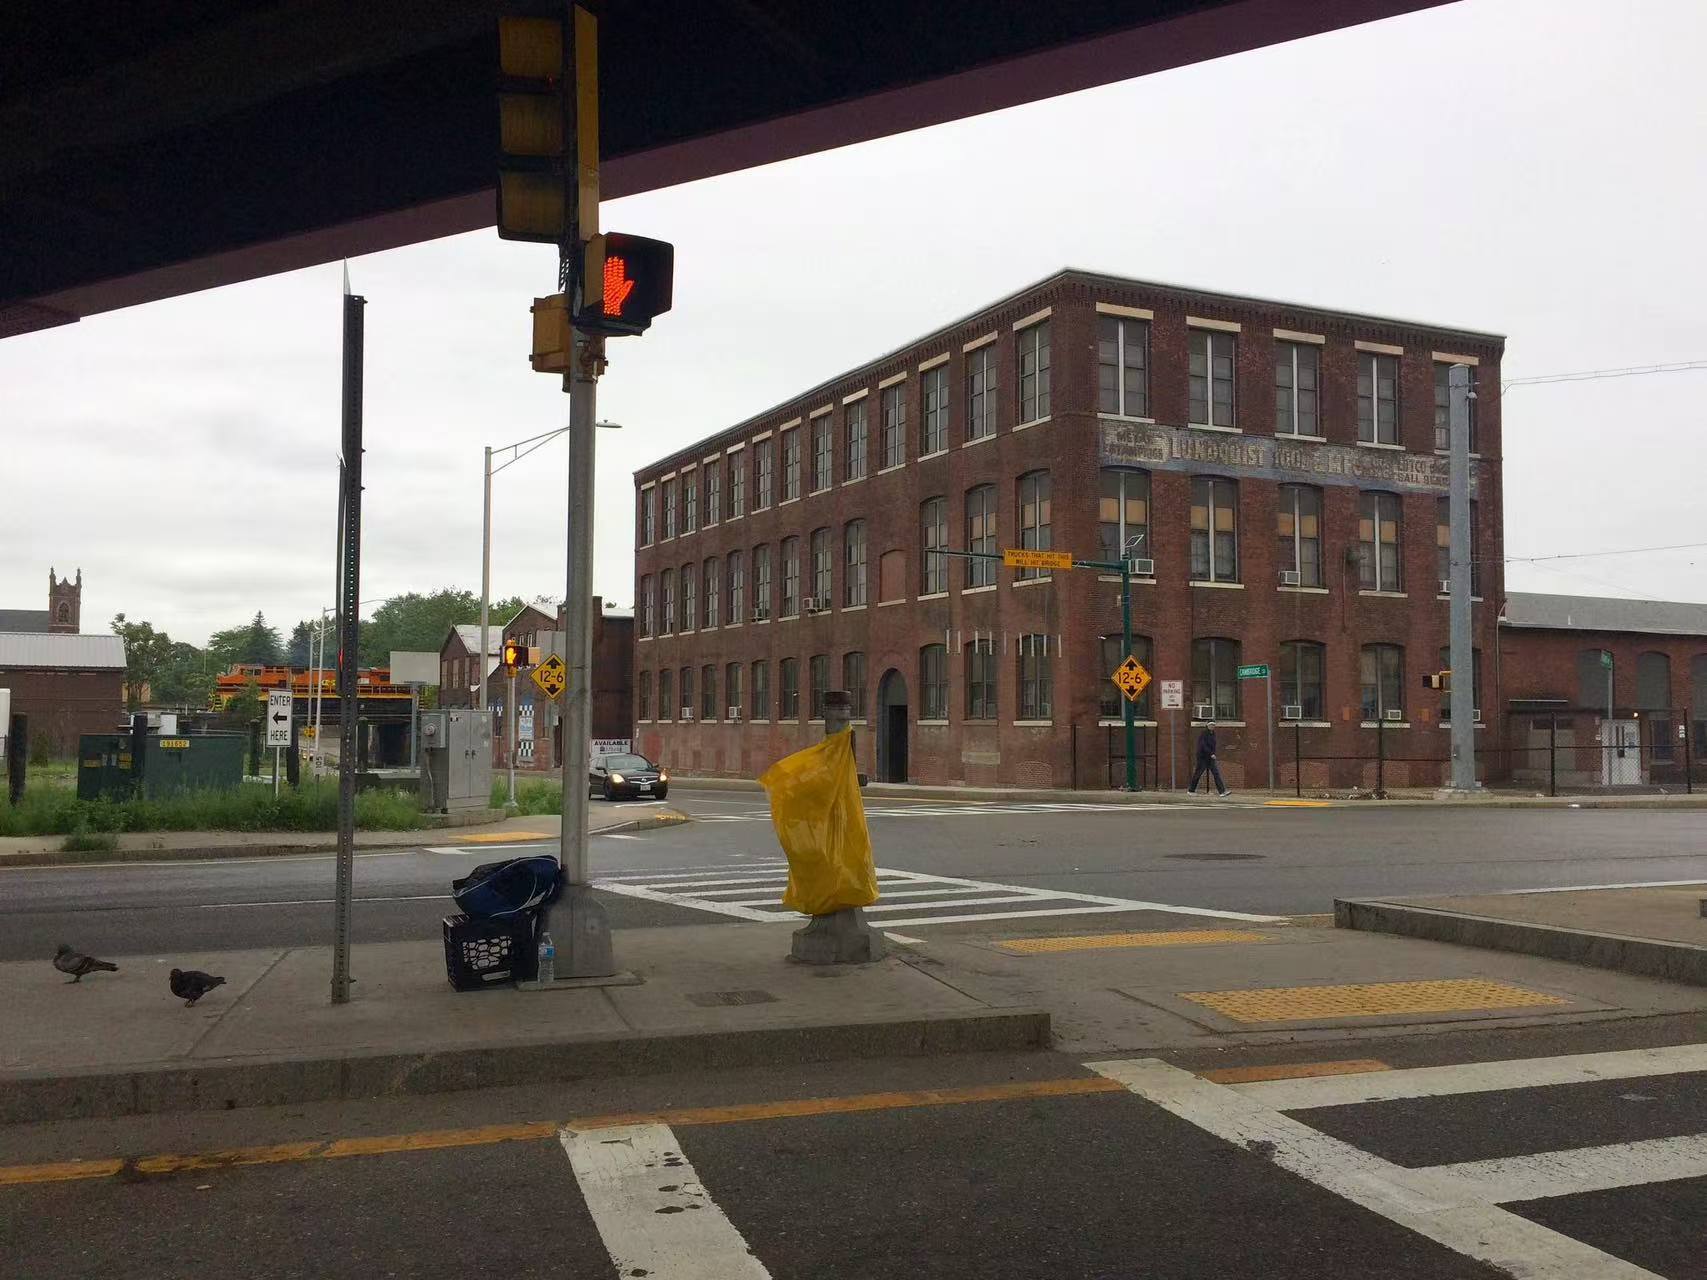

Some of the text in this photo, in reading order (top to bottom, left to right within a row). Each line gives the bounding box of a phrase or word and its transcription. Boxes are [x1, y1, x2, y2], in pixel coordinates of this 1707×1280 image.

[540, 670, 564, 683] 12-6
[1118, 672, 1142, 684] 12-6
[270, 695, 291, 706] ENTER
[270, 730, 288, 741] HERE
